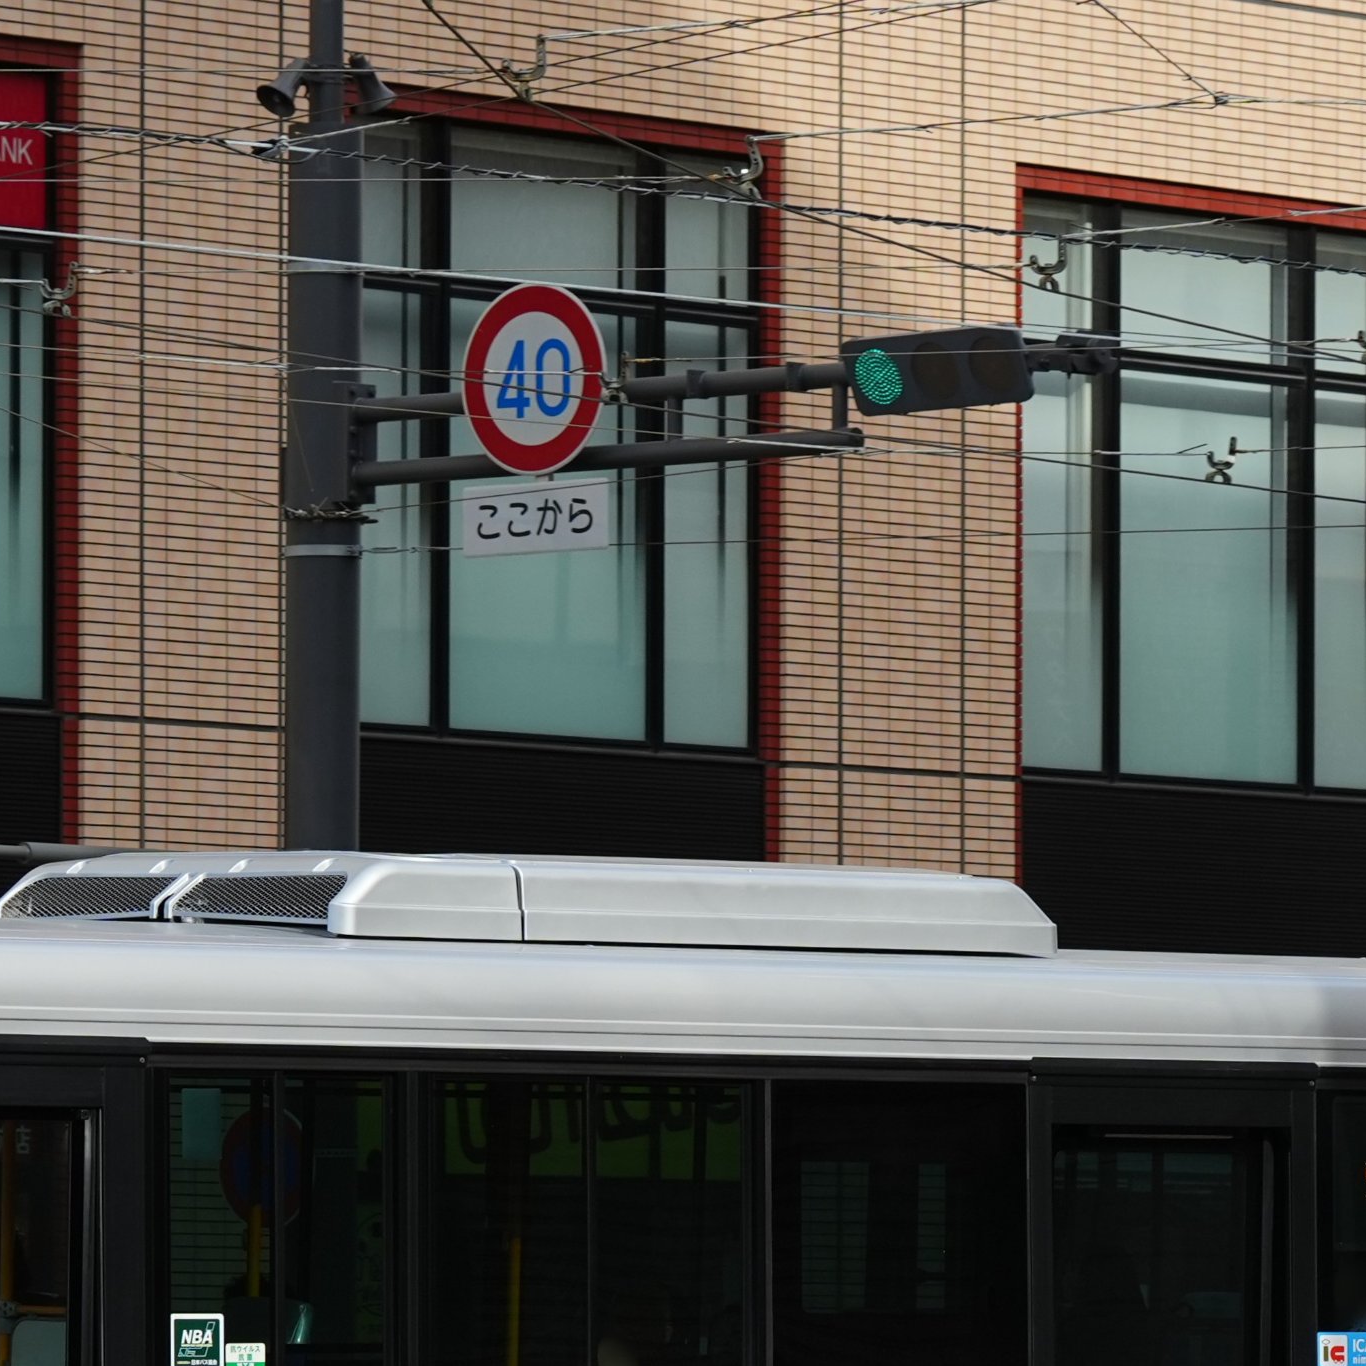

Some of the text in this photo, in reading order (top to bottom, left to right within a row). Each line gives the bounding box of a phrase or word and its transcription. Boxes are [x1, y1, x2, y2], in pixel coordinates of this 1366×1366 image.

[496, 337, 571, 419] 40
[476, 497, 594, 540] ここから
[181, 1329, 213, 1345] NBA
